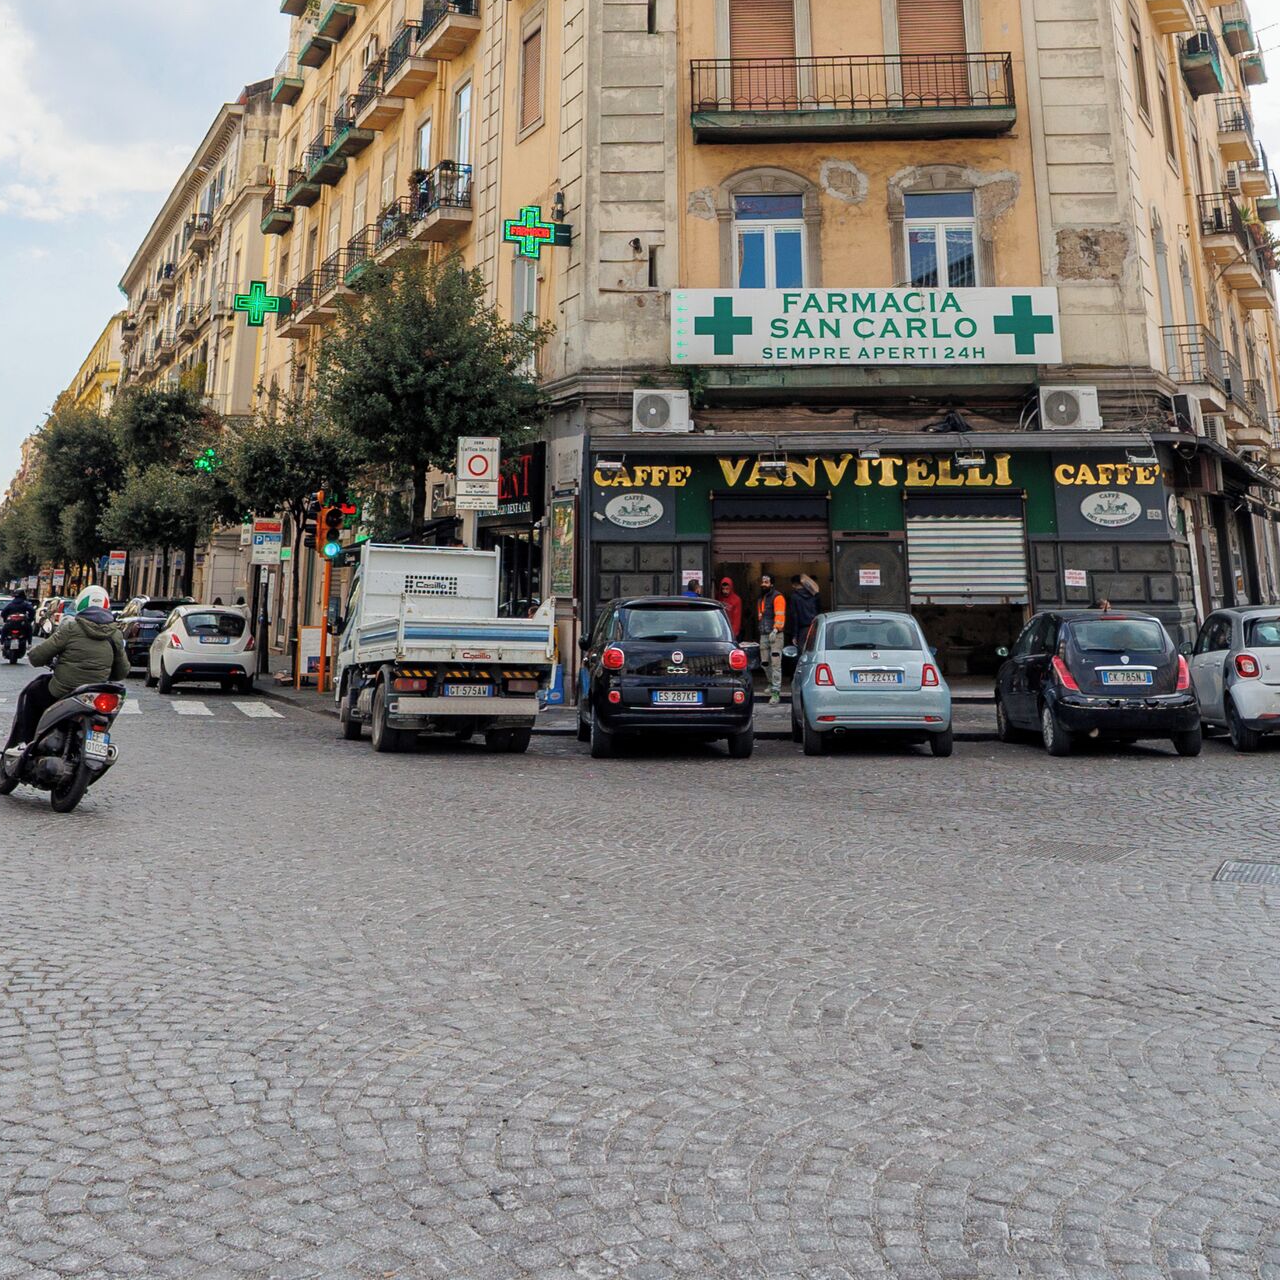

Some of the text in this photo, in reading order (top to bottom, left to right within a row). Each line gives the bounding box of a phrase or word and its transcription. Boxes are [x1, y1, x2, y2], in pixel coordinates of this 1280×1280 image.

[783, 292, 963, 314] FARMACIA
[770, 317, 978, 339] SAN CARLO
[762, 347, 986, 360] SEMPRE APERTI 24H
[593, 465, 692, 488] CAFFE'
[718, 453, 1013, 488] VANVITELLI
[1054, 463, 1162, 485] CAFFE'
[415, 581, 447, 590] Casillo
[1107, 672, 1147, 683] CK 785NJ
[657, 691, 698, 703] ES 287KF
